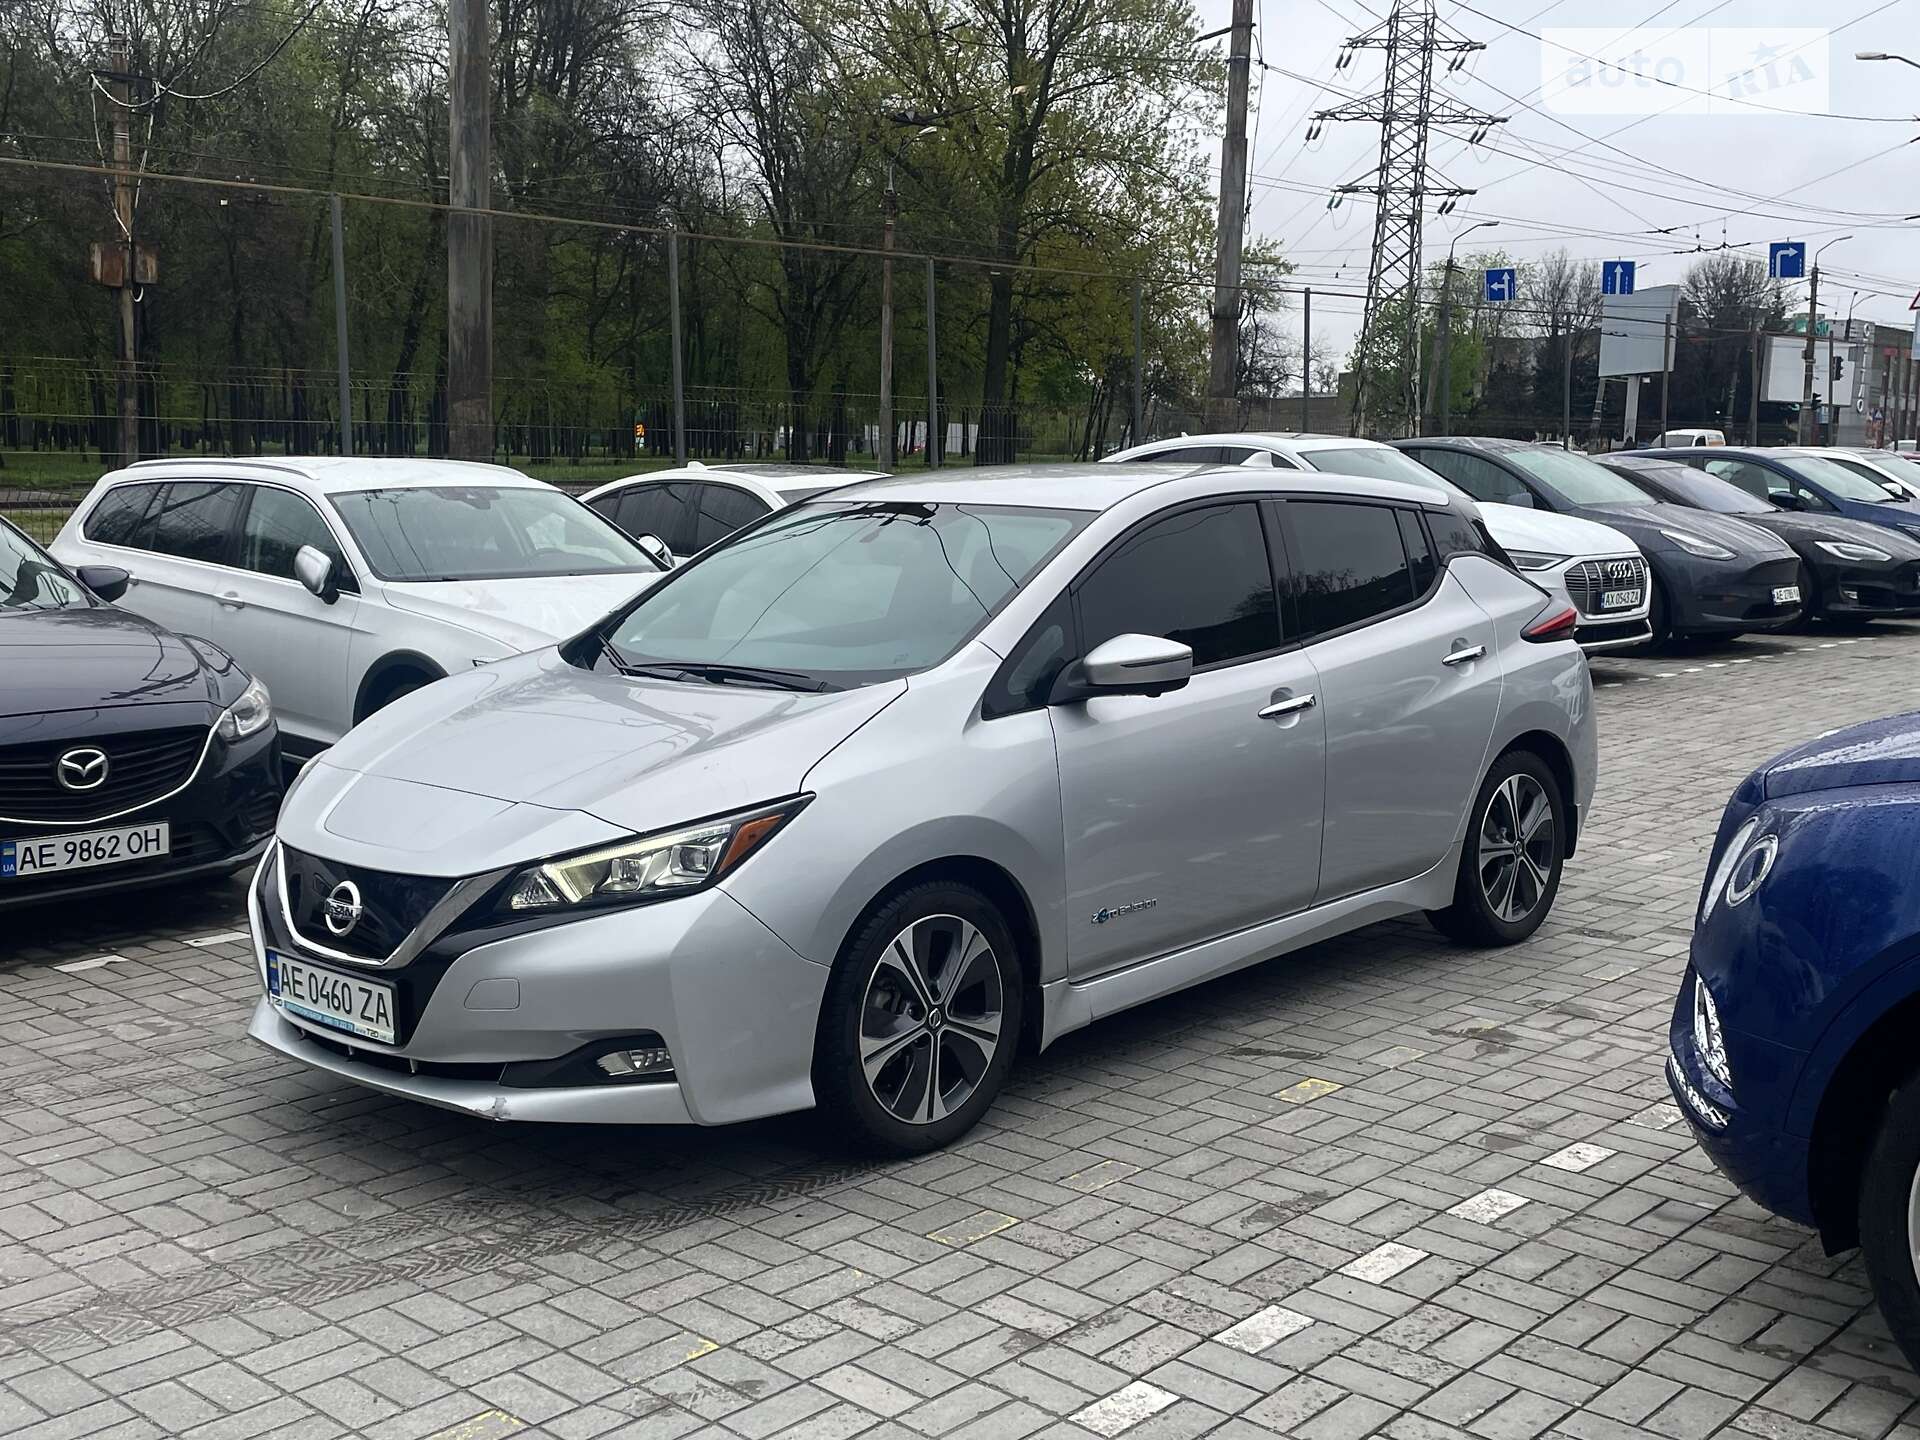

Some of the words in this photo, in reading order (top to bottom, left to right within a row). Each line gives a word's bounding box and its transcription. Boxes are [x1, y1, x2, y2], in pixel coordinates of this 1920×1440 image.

[3, 863, 16, 873] UA
[19, 843, 56, 871] AE
[63, 835, 121, 865] 9862
[127, 828, 160, 854] OH
[281, 962, 305, 1000] AE
[308, 972, 353, 1014] 0460
[358, 986, 390, 1027] ZA
